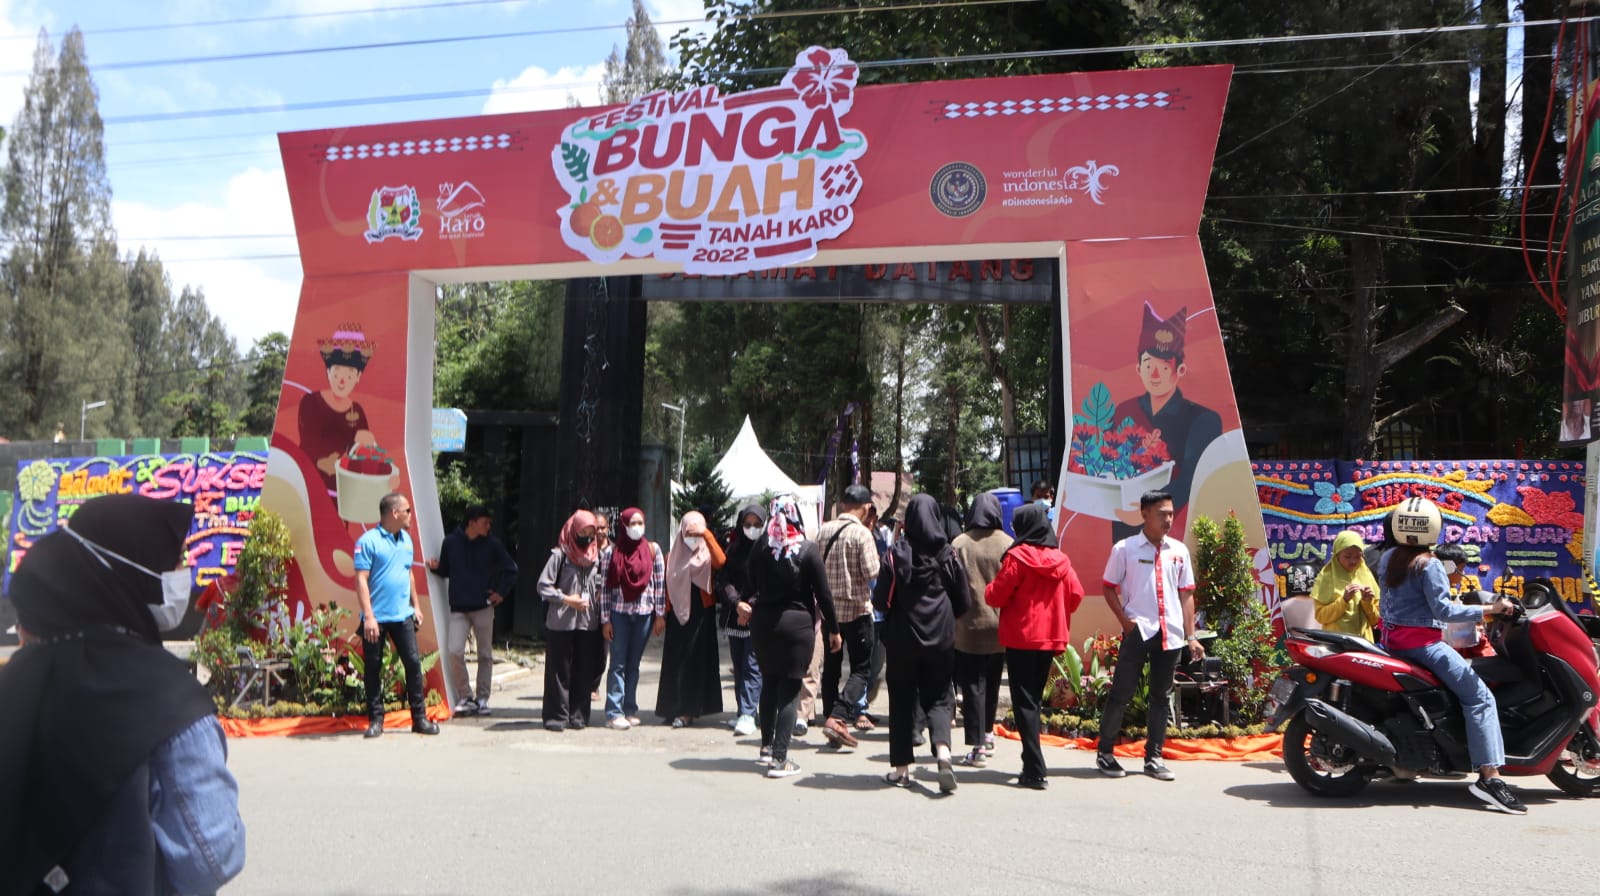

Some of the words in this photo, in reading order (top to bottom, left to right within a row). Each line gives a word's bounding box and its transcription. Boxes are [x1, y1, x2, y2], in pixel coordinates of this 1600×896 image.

[589, 86, 719, 130] FESTIVAL
[593, 104, 844, 176] BUNGA
[1003, 167, 1057, 178] wonderful
[1003, 178, 1078, 192] indonesia
[620, 159, 815, 225] BUAH
[709, 218, 782, 244] TANAH
[788, 204, 849, 235] KARO
[692, 246, 749, 263] 2022
[139, 462, 266, 498] SUKSE
[1265, 523, 1338, 541] TIVAL
[1445, 525, 1500, 543] DAN
